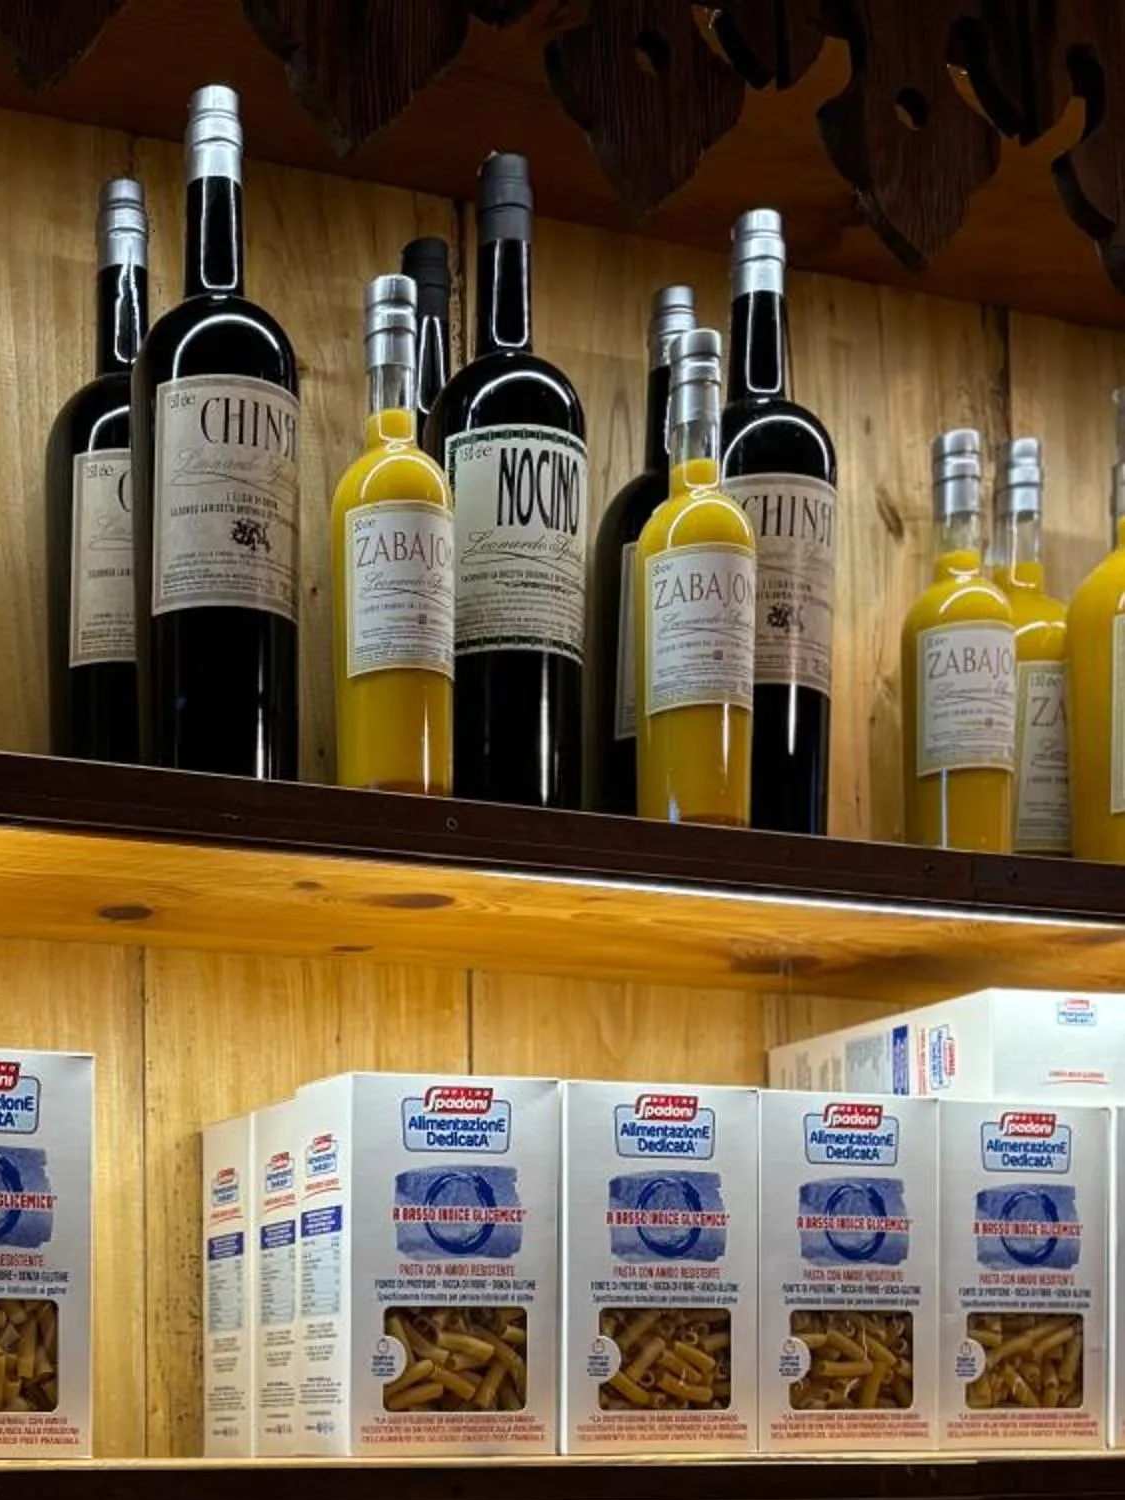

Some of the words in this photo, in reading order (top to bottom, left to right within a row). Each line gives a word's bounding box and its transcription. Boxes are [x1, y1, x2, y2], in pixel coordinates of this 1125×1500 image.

[497, 447, 580, 536] NOCINO
[422, 1088, 489, 1113] Spadoni
[635, 1097, 695, 1120] Spadoni
[823, 1106, 879, 1127] Spadoni
[998, 1114, 1054, 1136] Spadoni
[402, 1207, 436, 1223] BASSO
[438, 1208, 471, 1223] INDICE
